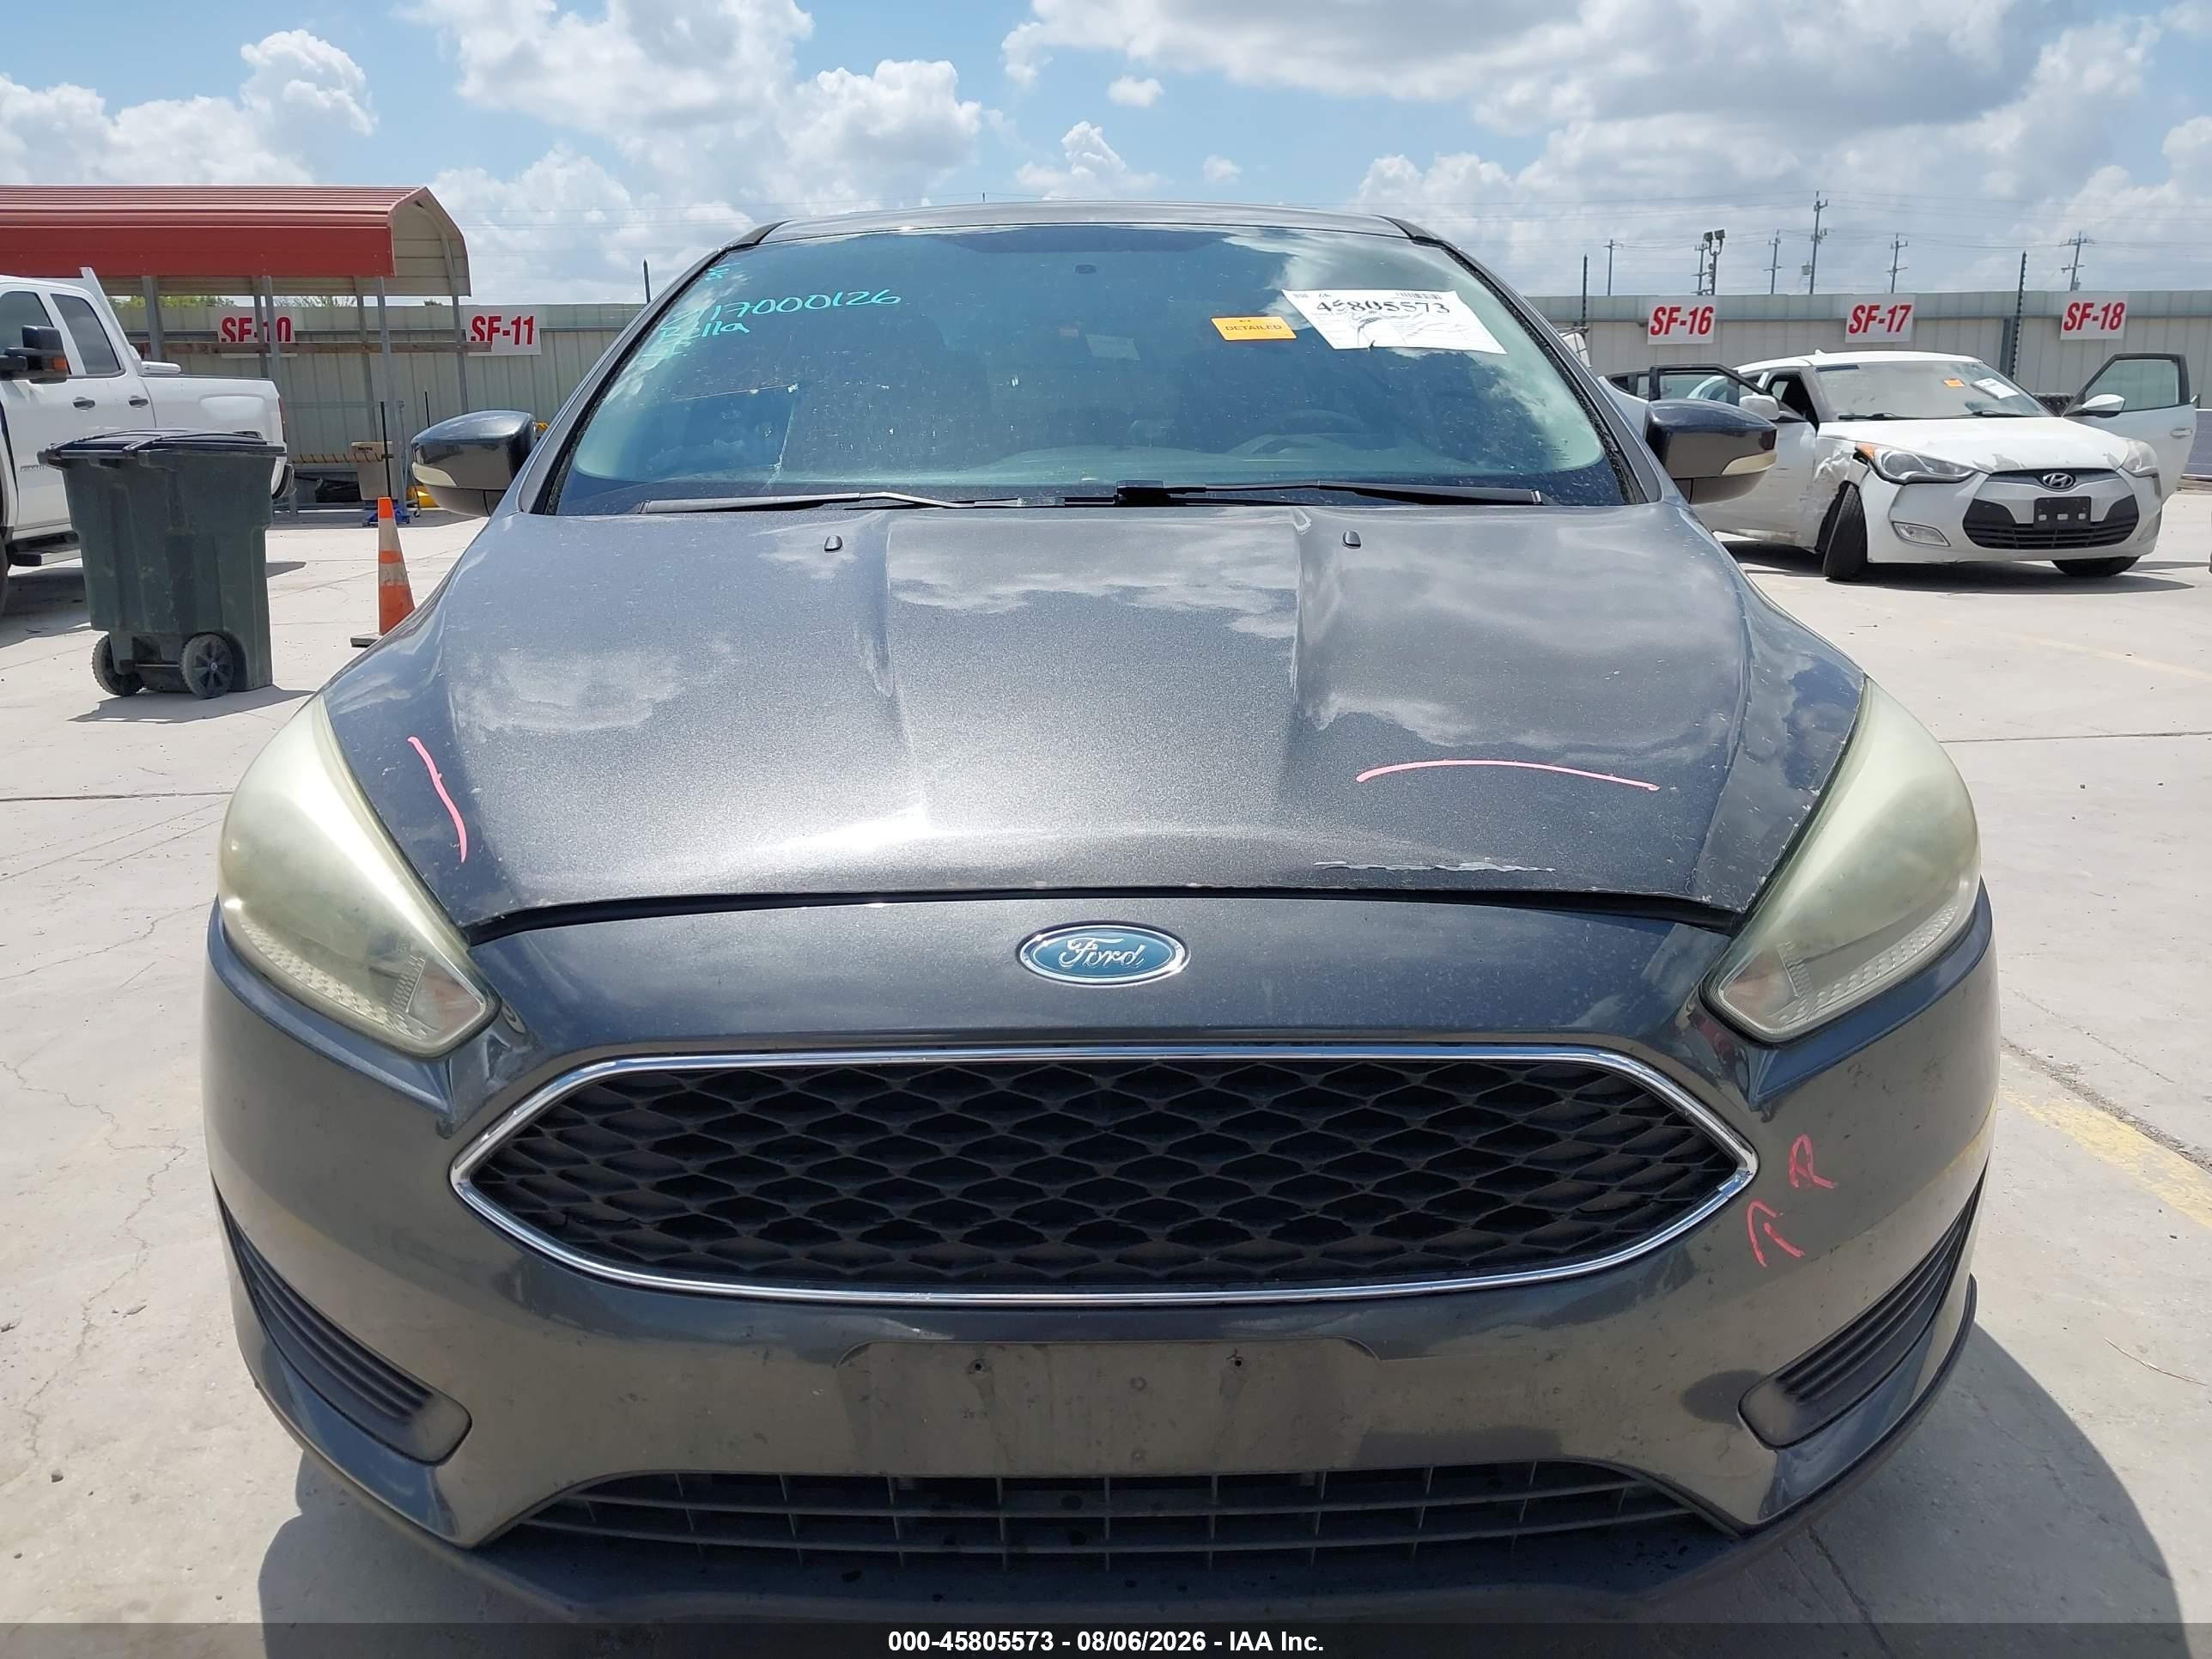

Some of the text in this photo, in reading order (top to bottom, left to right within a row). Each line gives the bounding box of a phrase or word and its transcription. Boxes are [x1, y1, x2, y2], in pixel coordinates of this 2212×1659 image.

[1316, 300, 1450, 314] 45805573
[1650, 306, 1713, 336] SF-16
[1848, 304, 1911, 334] SF-17
[2063, 301, 2125, 331] SF-18
[470, 315, 534, 345] SF-11
[1058, 937, 1147, 969] Ford
